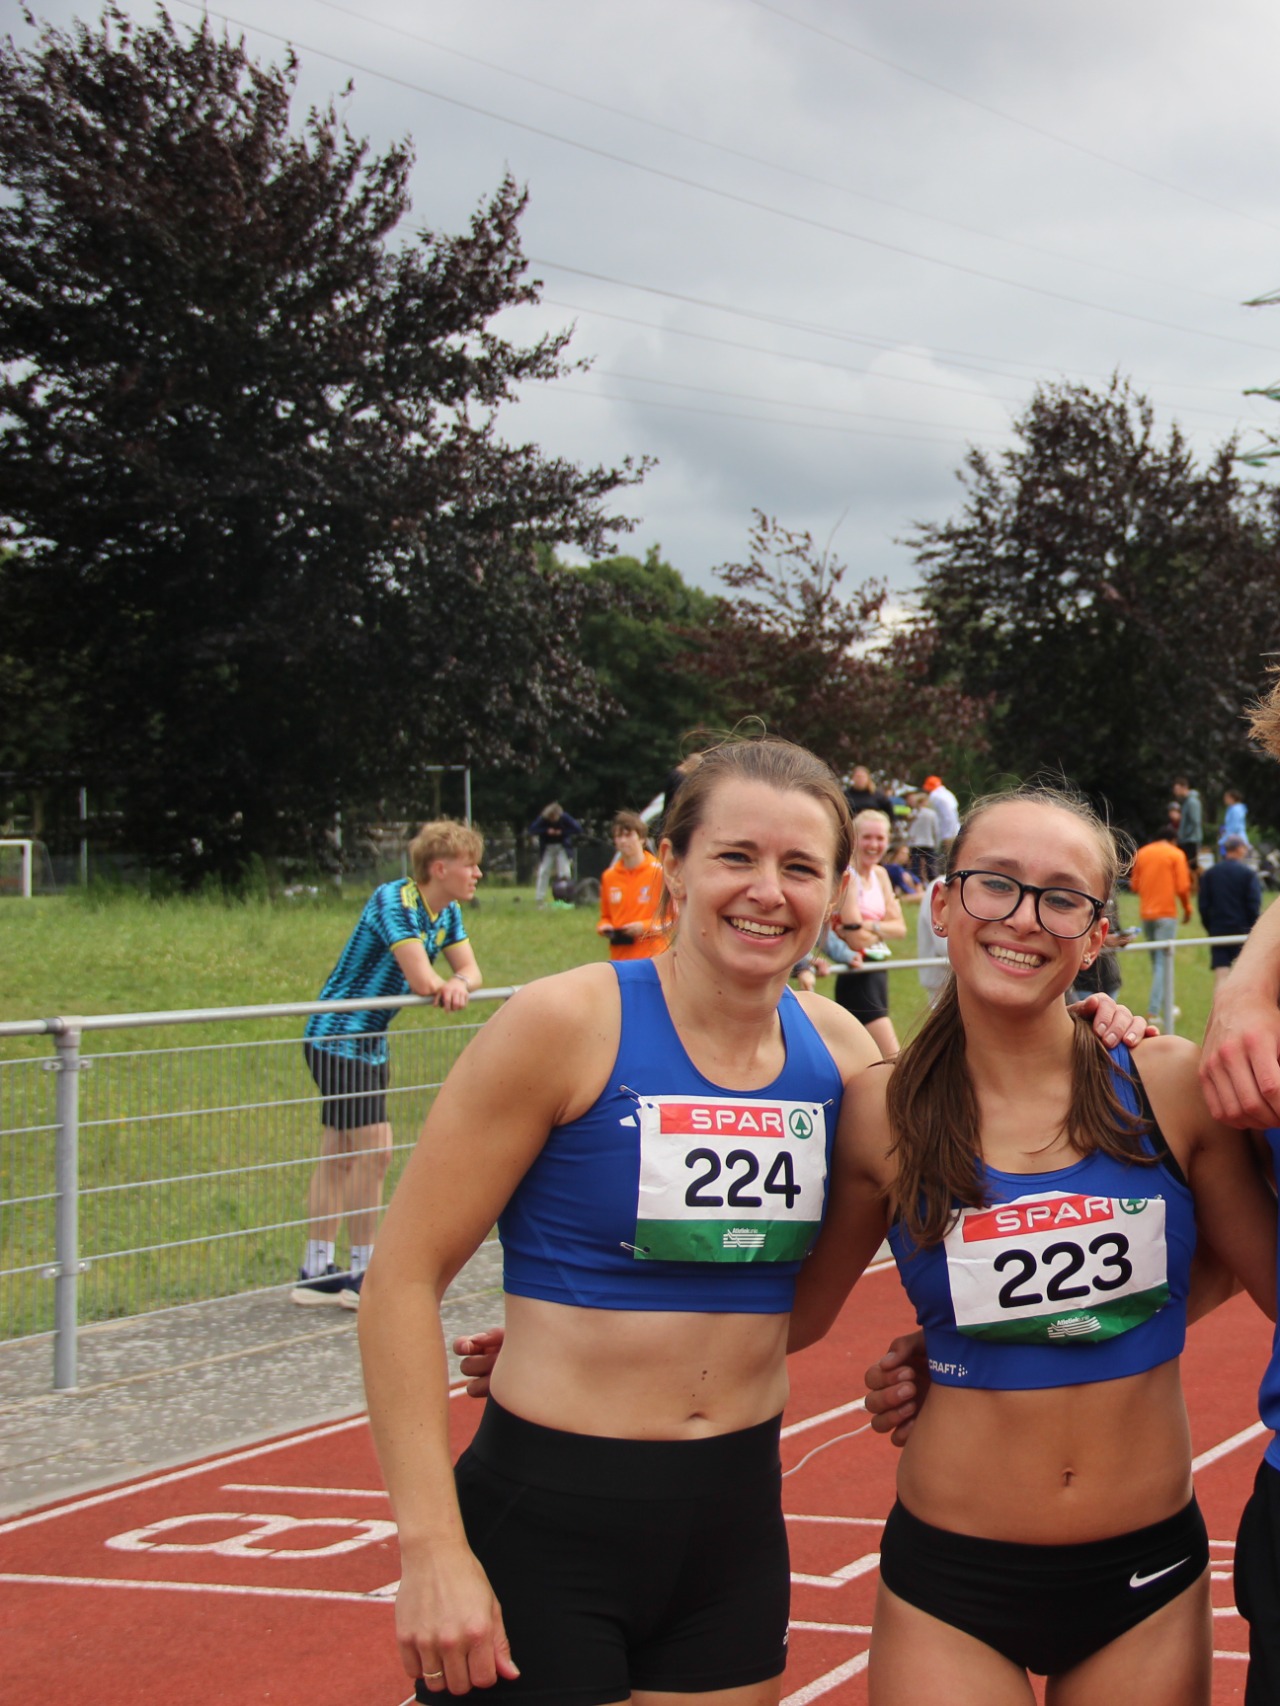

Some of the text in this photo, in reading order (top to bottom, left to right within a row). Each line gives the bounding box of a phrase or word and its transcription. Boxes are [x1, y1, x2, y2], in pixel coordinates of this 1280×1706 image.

[691, 1108, 783, 1133] SPAR
[684, 1147, 802, 1209] 224
[996, 1196, 1111, 1233] SPAR
[993, 1232, 1133, 1309] 223
[928, 1358, 957, 1375] CRAFT
[104, 1512, 399, 1560] 8
